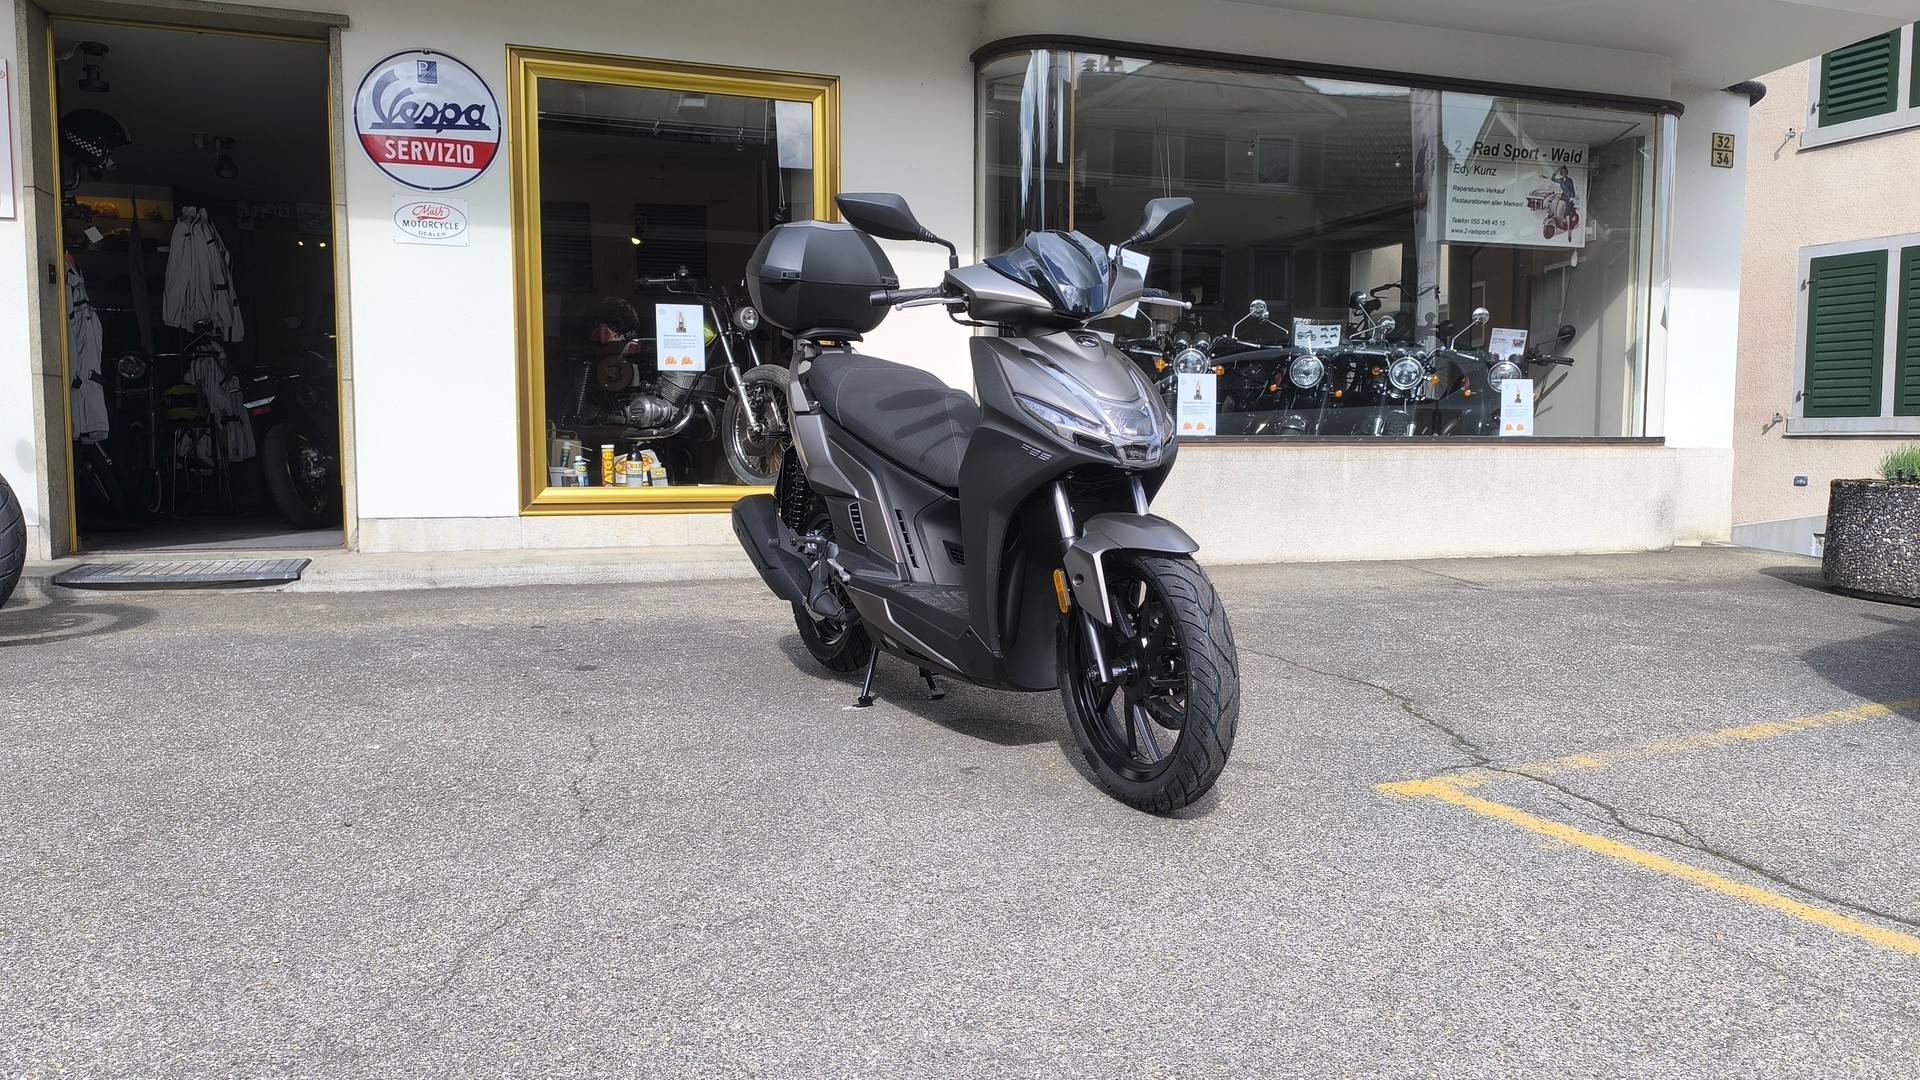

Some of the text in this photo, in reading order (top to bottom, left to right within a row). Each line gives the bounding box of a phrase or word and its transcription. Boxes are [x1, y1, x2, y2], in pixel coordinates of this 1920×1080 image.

[370, 69, 491, 134] Vespa
[1717, 135, 1731, 149] 32
[384, 139, 475, 164] SERVIZIO
[1453, 140, 1462, 154] 2
[1473, 142, 1500, 156] Rad
[1503, 143, 1540, 161] Sport
[1551, 147, 1583, 163] Wald
[1716, 152, 1730, 165] 34
[1453, 163, 1498, 176] Edy Kunz
[1452, 184, 1506, 195] Reparaturen-Verkauf
[1451, 196, 1490, 205] Restaurationen
[412, 204, 450, 217] Mash
[402, 219, 460, 231] MOTORCYCLE
[1451, 216, 1470, 225] Telefon
[418, 230, 447, 238] DEALER
[1450, 228, 1497, 236] www.2-radsport.ch
